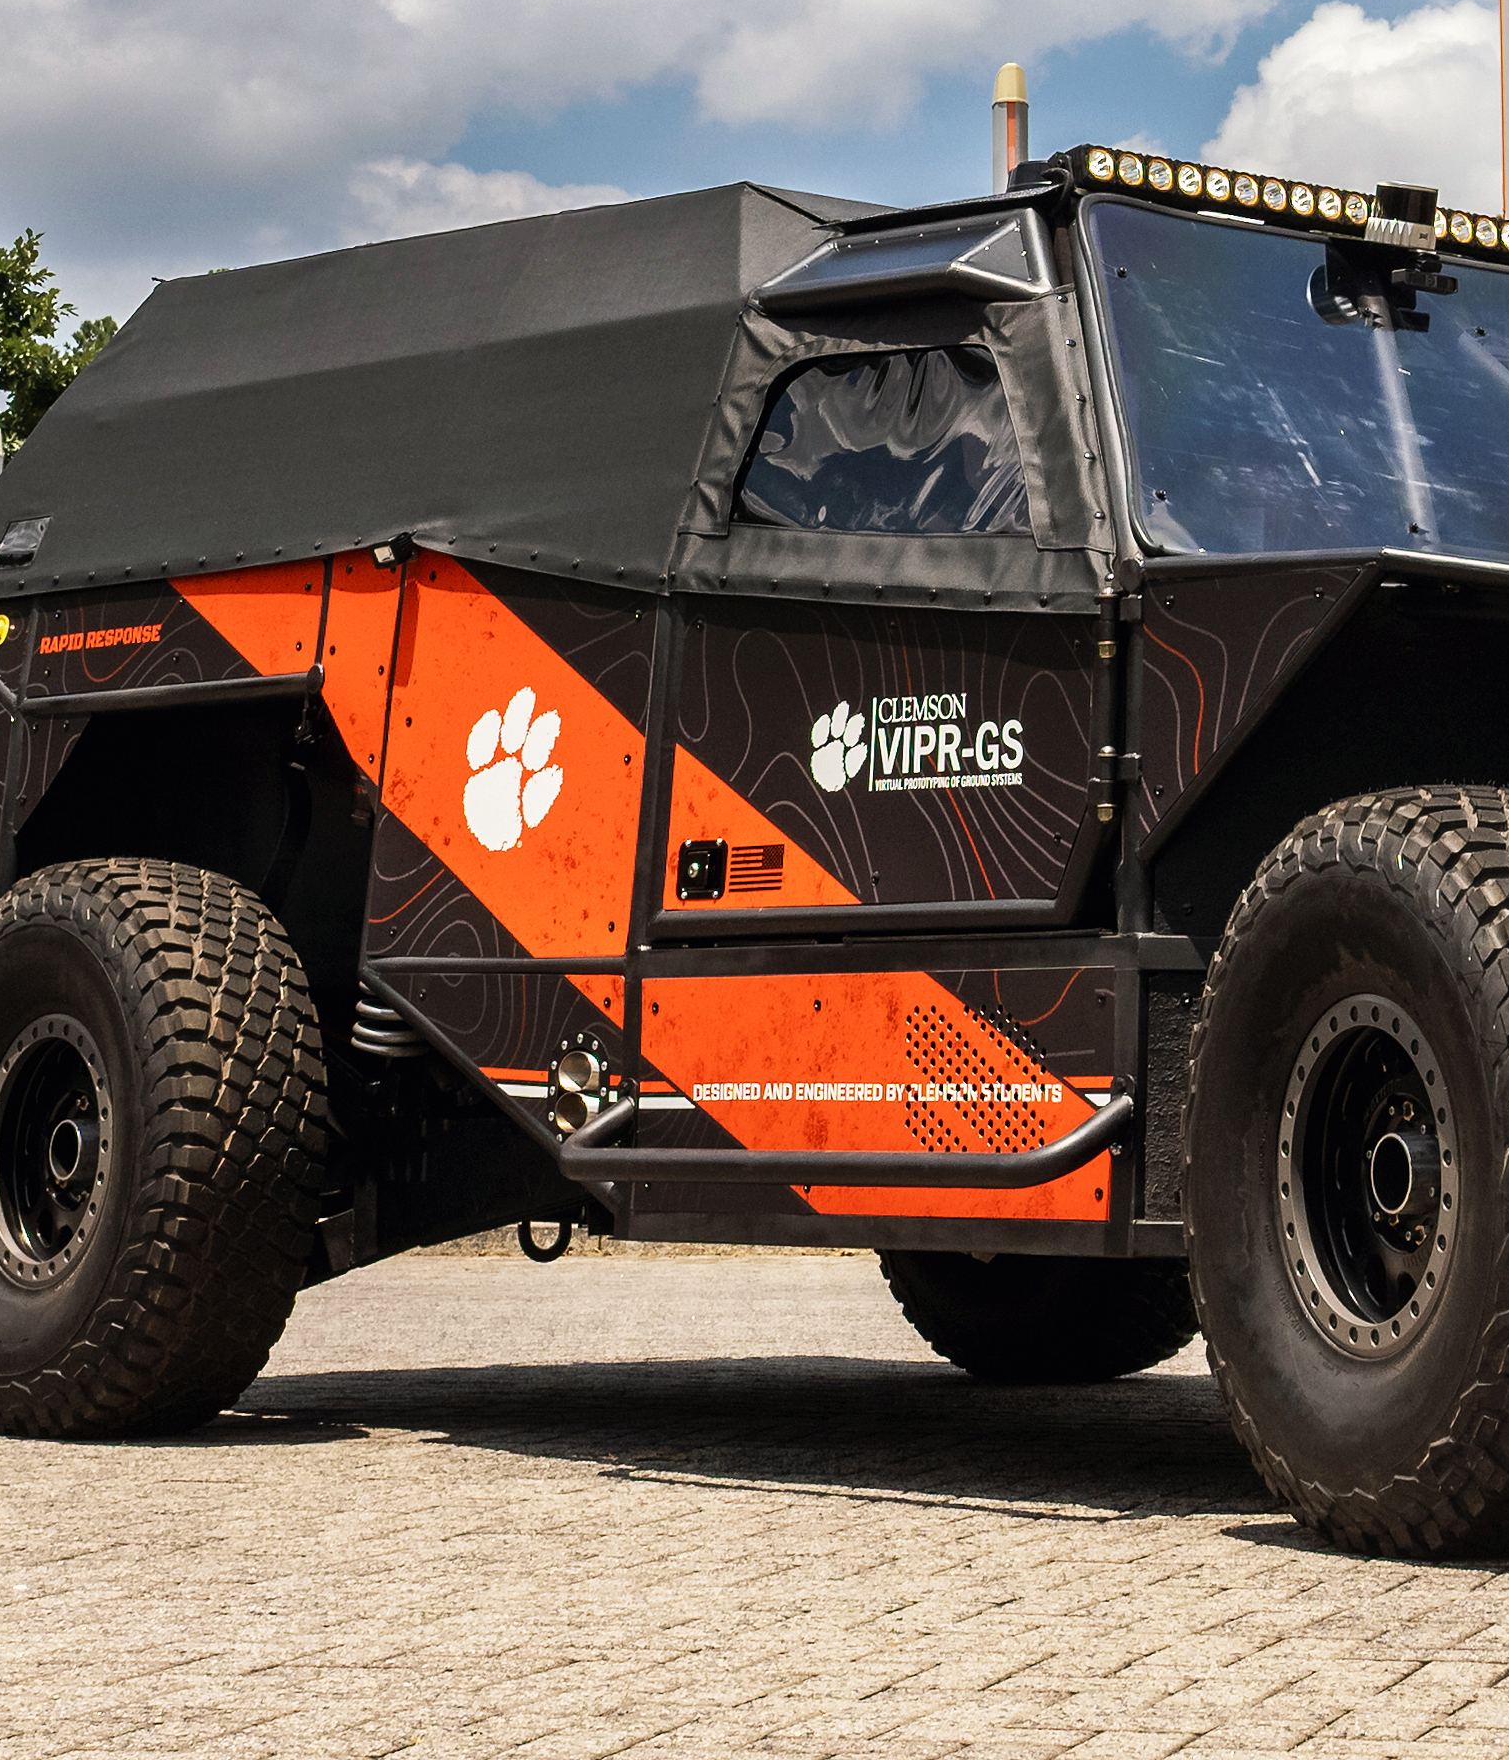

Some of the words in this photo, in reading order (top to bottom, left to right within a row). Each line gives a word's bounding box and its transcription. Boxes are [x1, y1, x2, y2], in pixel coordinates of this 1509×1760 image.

[39, 632, 85, 655] RAPID
[85, 624, 163, 649] RESPONSE
[878, 693, 967, 724] CLEMSON
[877, 719, 1024, 775] VIPR-GS
[875, 778, 903, 791] VIRTUAL
[903, 776, 950, 790] PROTOTYPING
[951, 775, 961, 787] OF
[961, 773, 991, 787] GROUND
[991, 772, 1023, 786] SYSTEMS
[693, 1083, 761, 1101] DESIGNED
[763, 1083, 793, 1100] AND
[795, 1083, 883, 1101] ENGINEERED
[886, 1084, 905, 1101] BY
[907, 1083, 978, 1102] CLEMSON
[979, 1083, 1062, 1103] STUDENTS
